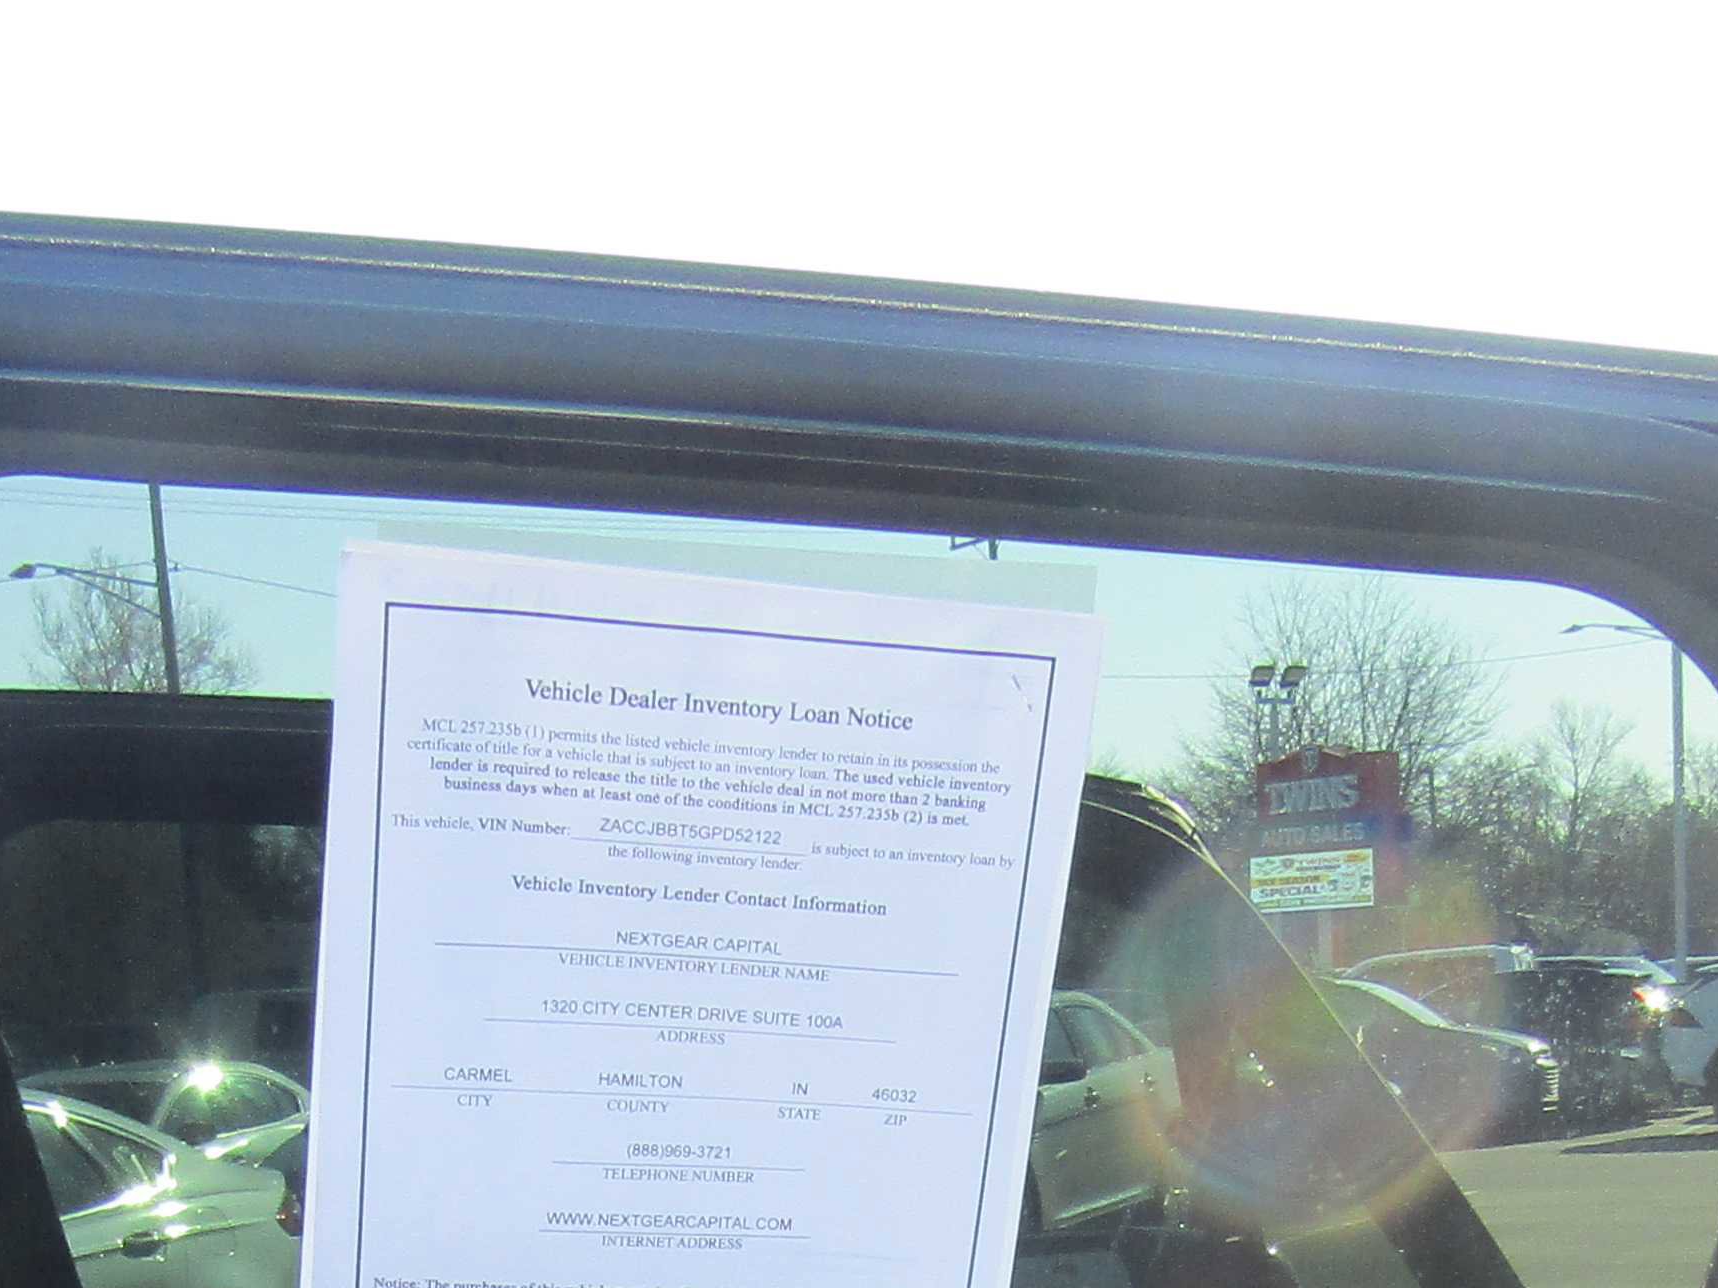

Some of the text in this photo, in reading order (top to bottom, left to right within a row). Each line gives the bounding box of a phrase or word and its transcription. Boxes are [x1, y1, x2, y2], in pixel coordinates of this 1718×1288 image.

[527, 679, 912, 728] Vehicle Dealer Inventory Loan Notice
[422, 719, 457, 733] MCL
[548, 727, 597, 745] permits
[601, 731, 621, 743] the
[625, 732, 660, 746] listed
[662, 737, 710, 750] vehicle
[714, 741, 776, 758] inventory
[779, 745, 818, 758] lender
[837, 750, 873, 762] retain
[911, 754, 977, 774] possession
[981, 759, 999, 772] the
[407, 737, 471, 753] certificate
[493, 743, 519, 756] title
[557, 747, 603, 762] vehicle
[607, 751, 631, 764] that
[649, 754, 697, 772] subject
[735, 760, 795, 779] inventory
[833, 767, 859, 781] The
[863, 769, 893, 783] used
[898, 772, 945, 787] vehicle
[949, 776, 1011, 796] inventory
[430, 758, 985, 811] lender is required to release the title to the vehicle deal in not more than 2 banking
[1264, 774, 1360, 815] TWINS
[443, 777, 501, 792] business
[505, 781, 536, 798] days
[541, 784, 577, 798] when
[582, 787, 595, 799] at
[600, 788, 631, 801] least
[635, 793, 662, 804] one
[663, 792, 680, 805] of
[683, 793, 703, 806] the
[705, 795, 777, 812] conditions
[782, 800, 794, 813] in
[799, 802, 834, 816] MCL
[927, 811, 937, 823] is
[388, 814, 420, 826] This
[477, 818, 506, 831] VIN
[512, 820, 570, 835] Number:
[607, 845, 629, 858] the
[631, 847, 693, 866] following
[697, 851, 757, 871] inventory
[825, 843, 1015, 870] subject to an inventory loan by
[513, 876, 886, 915] Vehicle Inventory Lender Contact Information
[616, 932, 782, 955] NEXTGEAR CAPITAL
[558, 953, 829, 980] VEHICLE INVENTORY LENDER NAME
[541, 999, 843, 1028] 1320 CITY CENTER DRIVE SUITE 100A
[657, 1030, 725, 1044] ADDRESS
[444, 1067, 513, 1083] CARMEL
[599, 1072, 682, 1088] HAMILTON
[792, 1082, 807, 1096] IN
[871, 1087, 916, 1103] 46032
[457, 1094, 491, 1107] CITY
[607, 1098, 669, 1113] COUNTY
[777, 1106, 821, 1121] STATE
[884, 1112, 906, 1127] ZIP
[627, 1143, 730, 1159] (888)969-3721
[602, 1167, 754, 1184] TELEPHONE NUMBER
[546, 1212, 793, 1231] WWW.NEXTGEARCAPITAL.COM
[602, 1235, 742, 1250] INTERNET ADDRESS
